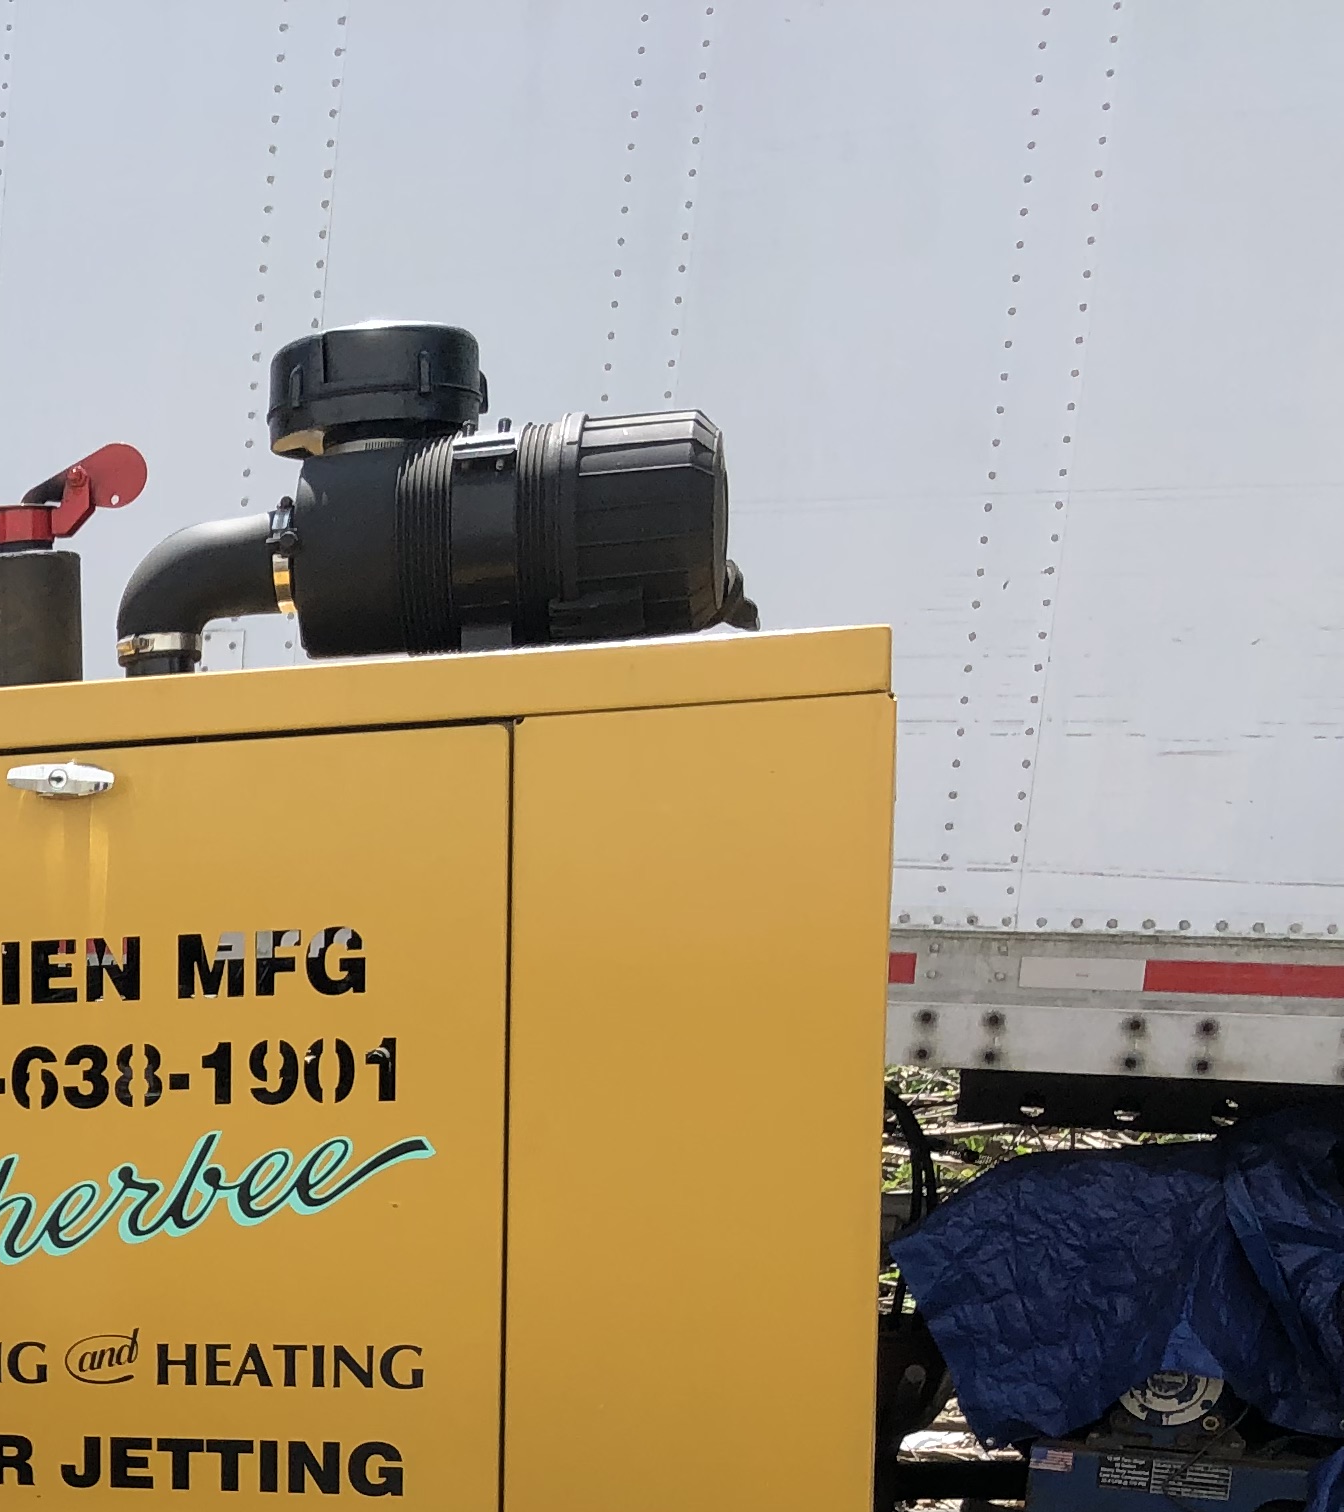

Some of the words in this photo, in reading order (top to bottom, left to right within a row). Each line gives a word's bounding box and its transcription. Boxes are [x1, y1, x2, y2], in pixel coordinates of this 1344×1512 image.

[177, 925, 367, 1000] MFG
[65, 1328, 139, 1385] and
[156, 1344, 425, 1389] HEATING
[60, 1437, 404, 1497] JETTING
